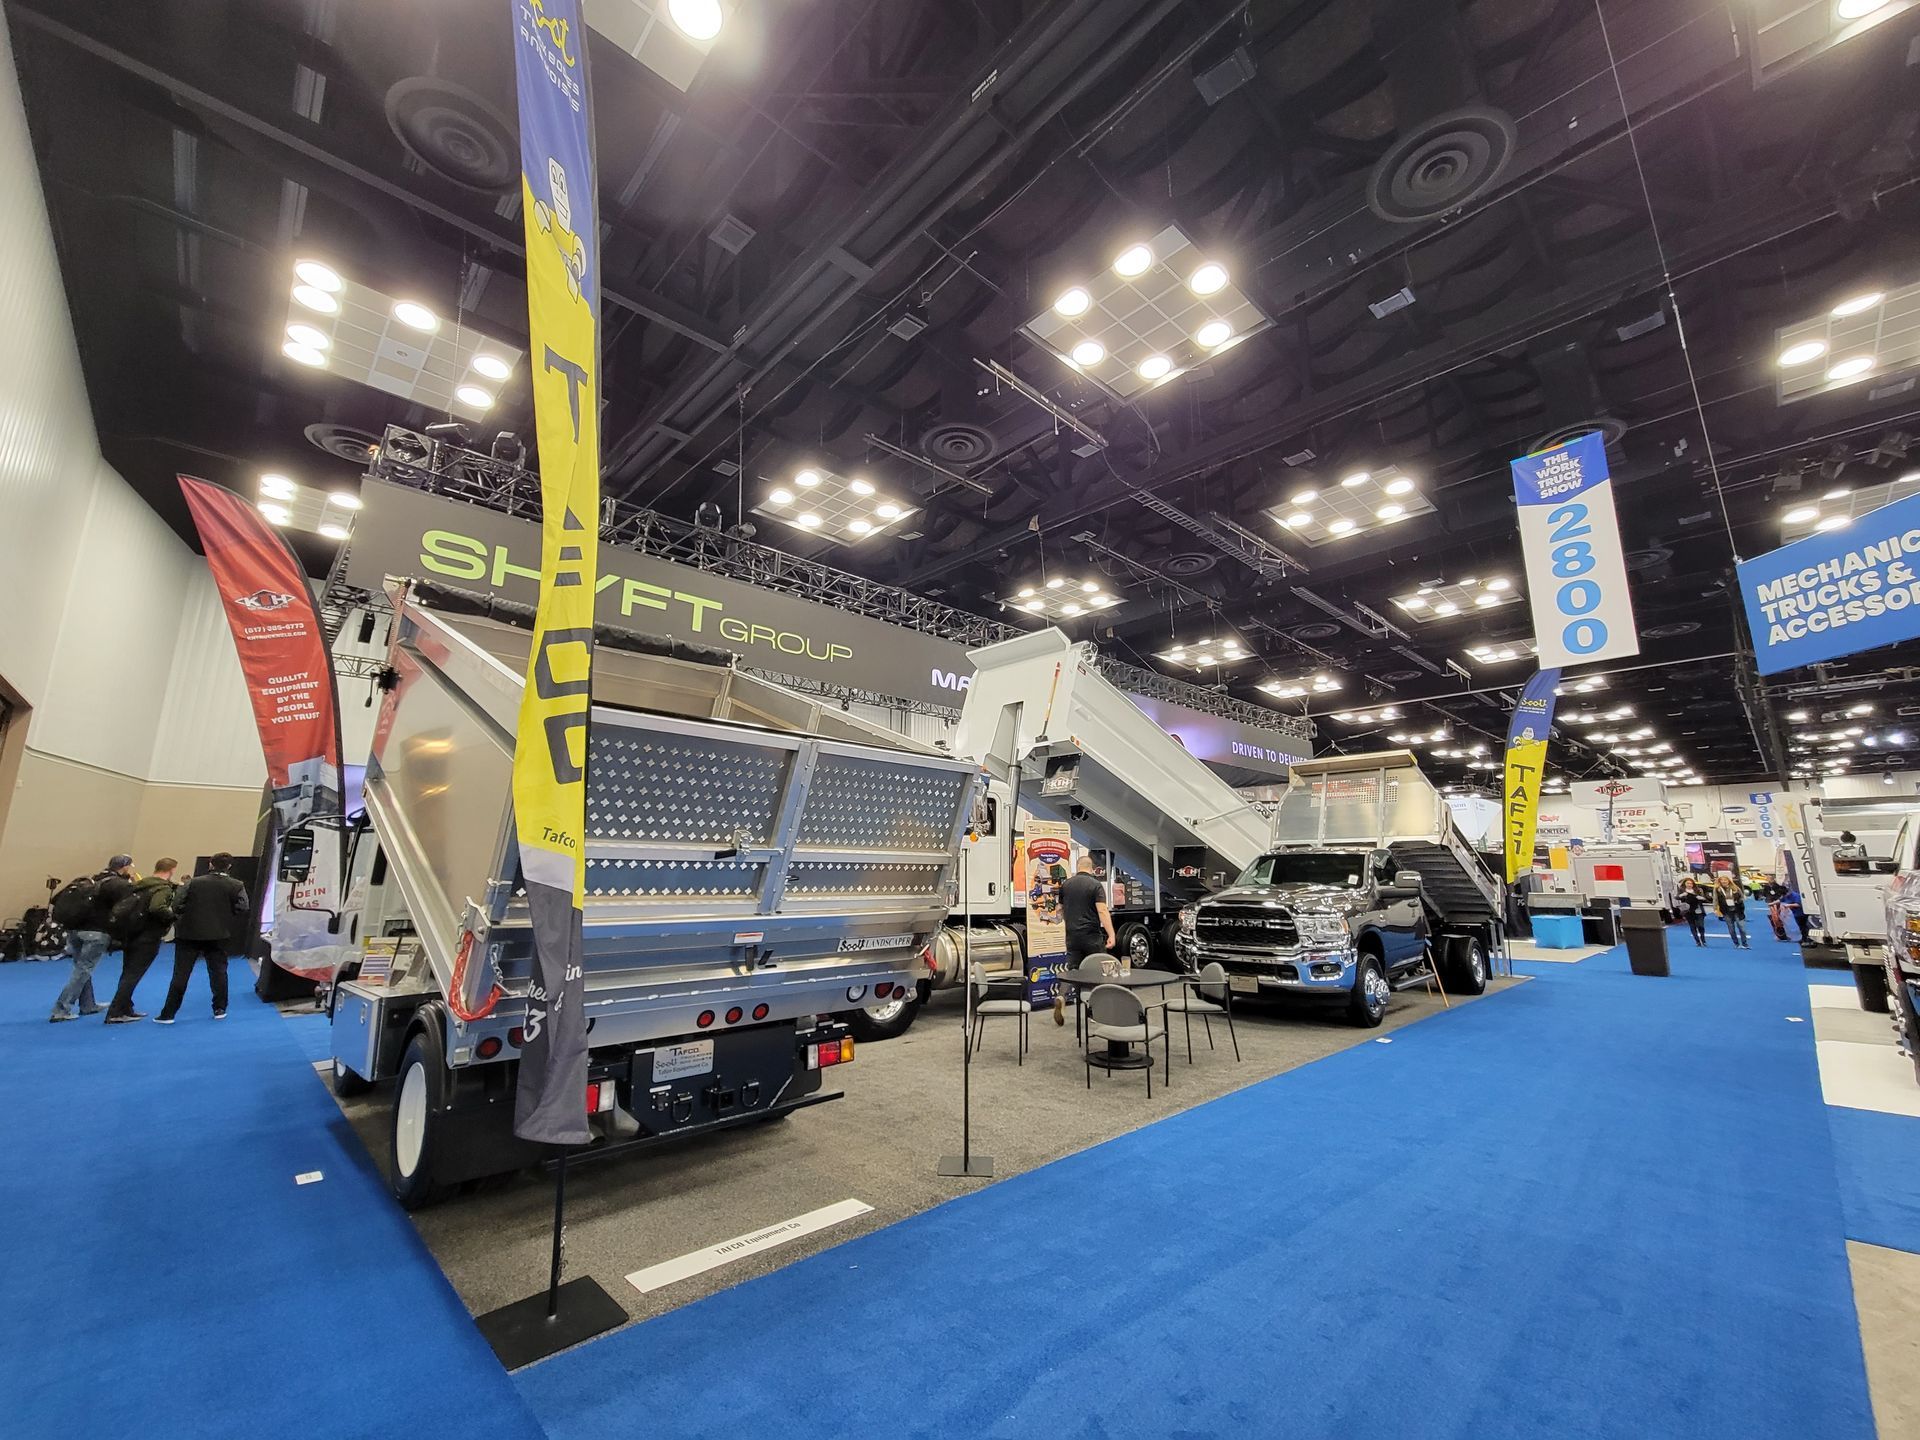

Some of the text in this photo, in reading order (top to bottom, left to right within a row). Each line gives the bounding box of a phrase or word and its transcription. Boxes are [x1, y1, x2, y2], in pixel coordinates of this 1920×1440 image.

[1536, 458, 1581, 479] WORK
[1543, 451, 1569, 467] THE
[1538, 469, 1582, 489] TRUCK
[1540, 478, 1583, 499] SHOW
[1547, 503, 1609, 655] 2800
[1761, 561, 1917, 623] TRUCKS &
[719, 618, 854, 664] GROUP
[268, 671, 309, 685] QUALITY
[261, 681, 319, 696] EQUIPMENT
[276, 692, 310, 704] BY THE
[271, 711, 320, 724] YOU TRUST
[276, 702, 315, 714] PEOPLE
[1231, 741, 1264, 760] DRIVEN
[1265, 749, 1277, 763] TO
[1759, 805, 1774, 838] 3600
[542, 826, 576, 849] Tafco
[313, 887, 326, 896] IN
[865, 936, 911, 949] LANDSCAPER
[669, 1046, 700, 1057] TAFCO
[714, 1222, 802, 1256] TAFCO Equipment Co
